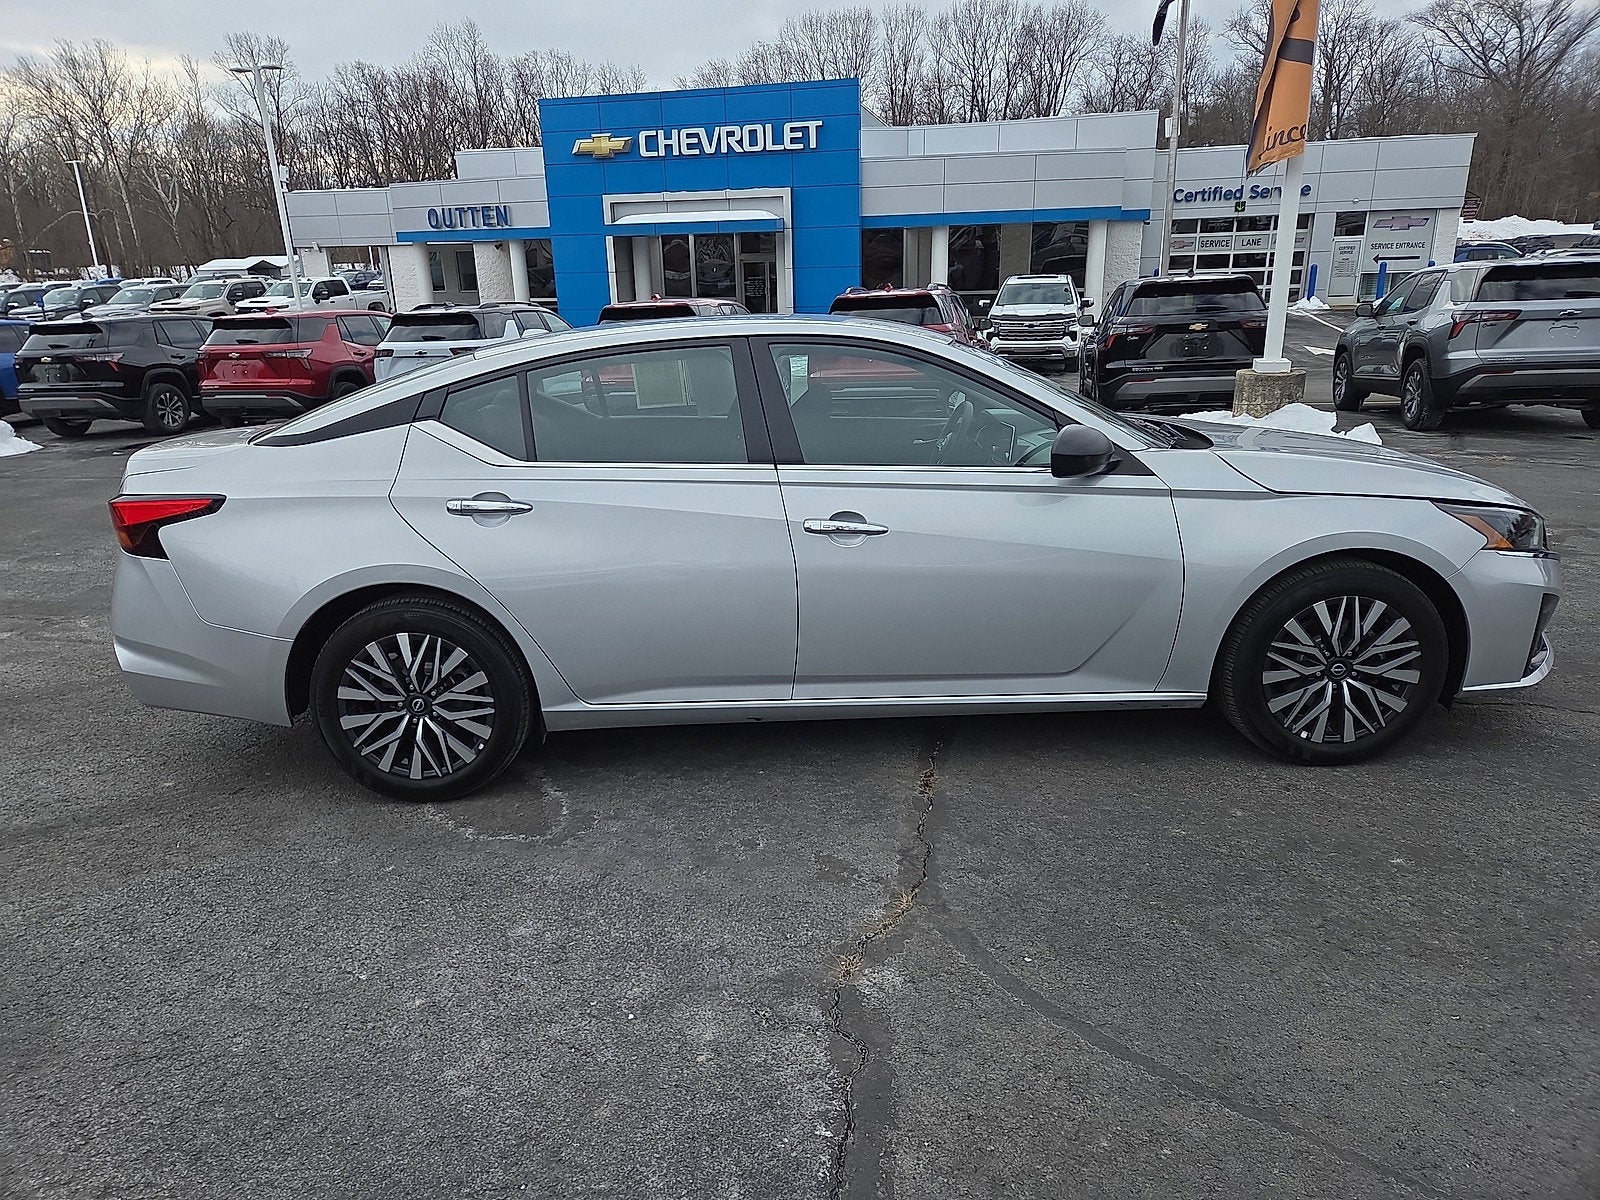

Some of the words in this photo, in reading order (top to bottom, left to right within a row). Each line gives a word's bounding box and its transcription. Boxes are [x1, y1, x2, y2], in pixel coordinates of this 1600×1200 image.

[638, 120, 823, 158] CHEVROLET
[1173, 184, 1244, 203] Certified
[427, 205, 510, 230] OUTTEN
[1200, 239, 1230, 248] SERVICE
[1241, 238, 1262, 247] LANE
[1370, 242, 1394, 250] SERVICE
[1395, 241, 1426, 250] ENTRANCE
